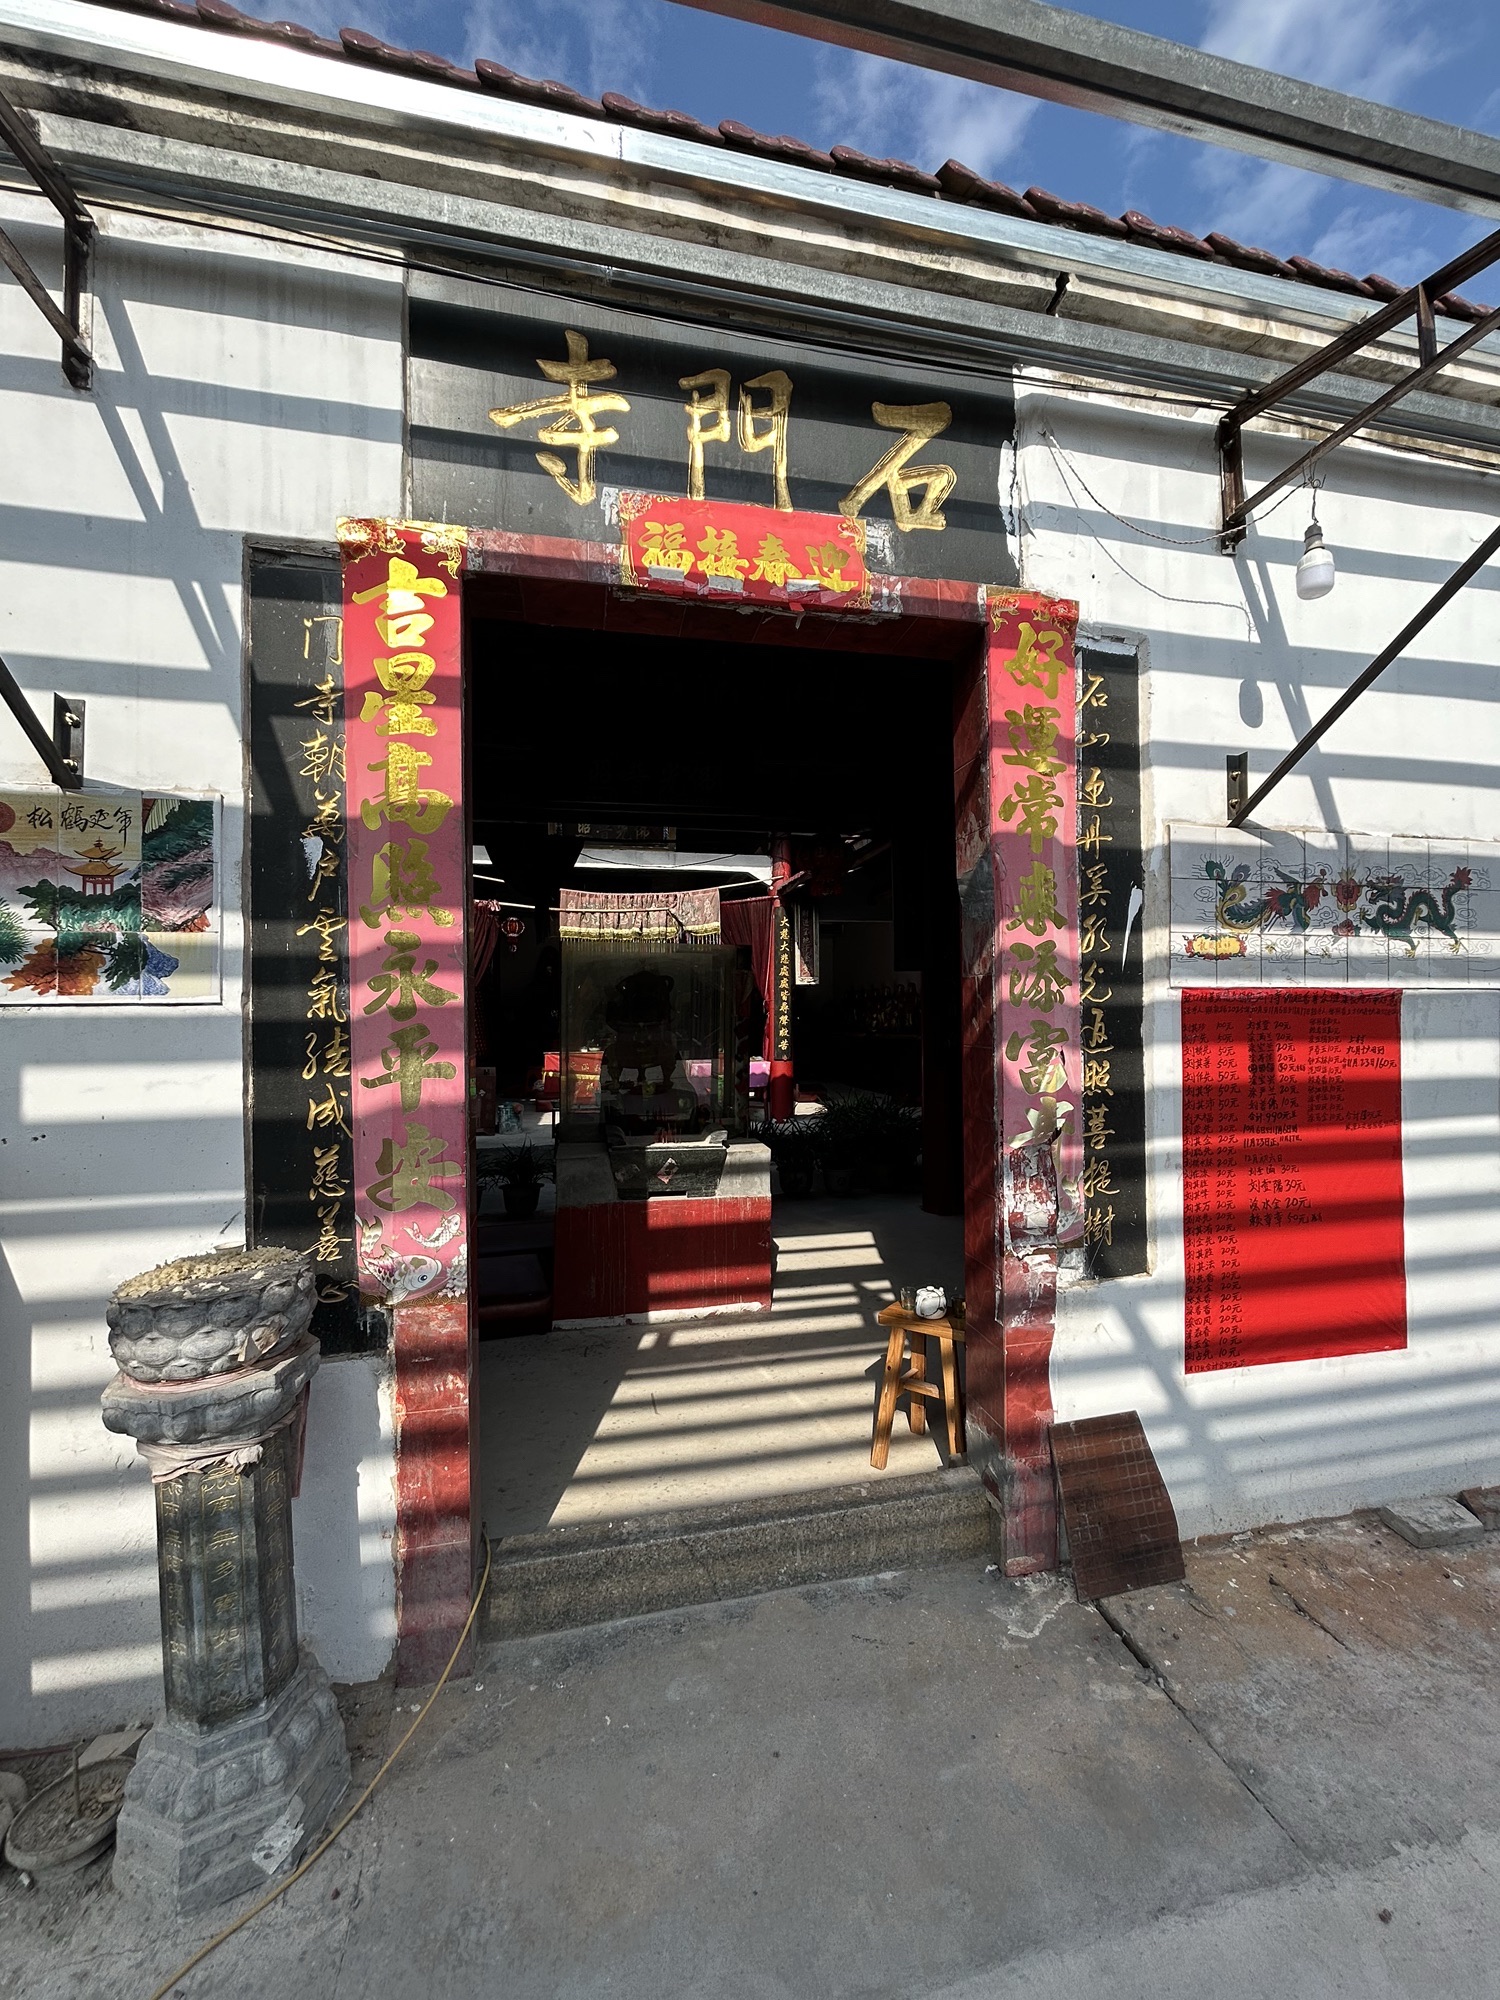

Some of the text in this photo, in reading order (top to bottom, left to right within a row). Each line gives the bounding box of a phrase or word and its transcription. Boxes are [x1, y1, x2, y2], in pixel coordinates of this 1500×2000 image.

[487, 329, 959, 532] 石門寺
[640, 521, 859, 592] 迎春接福
[352, 556, 463, 1213] 吉星高照永平安
[1273, 1021, 1291, 1030] 20元
[1217, 1033, 1234, 1043] 50元
[1276, 1033, 1294, 1041] 20元
[1218, 1046, 1235, 1056] 50元
[1275, 1042, 1296, 1052] 20元
[1277, 1053, 1296, 1062] 20元
[1216, 1058, 1238, 1069] 50元
[1217, 1070, 1240, 1082] 50元
[1279, 1074, 1297, 1083] 20元
[1217, 1083, 1241, 1097] 50元
[1280, 1085, 1299, 1094] 20元
[1217, 1098, 1240, 1111] 50元
[1281, 1097, 1299, 1108] 10元
[1218, 1112, 1238, 1122] 30元
[1218, 1125, 1237, 1133] 20元
[1218, 1135, 1239, 1144] 20元
[1217, 1146, 1237, 1155] 20元
[1217, 1157, 1237, 1167] 20元
[1216, 1169, 1236, 1178] 20元
[1281, 1164, 1300, 1174] 30元
[1216, 1179, 1236, 1188] 20元
[1284, 1179, 1306, 1193] 30元
[1216, 1200, 1236, 1210] 20元
[1284, 1196, 1312, 1210] 20元
[1215, 1212, 1235, 1221] 20元
[1287, 1212, 1309, 1224] 50元
[1215, 1224, 1236, 1233] 20元
[1217, 1235, 1238, 1245] 20元
[1221, 1246, 1239, 1255] 20元
[1221, 1259, 1240, 1269] 20元
[1221, 1271, 1241, 1281] 20元
[1221, 1281, 1241, 1290] 20元
[1220, 1292, 1242, 1303] 20元
[1220, 1303, 1242, 1314] 20元
[1219, 1315, 1243, 1324] 20元
[1219, 1325, 1242, 1335] 20元
[1219, 1335, 1242, 1346] 10元
[1219, 1347, 1240, 1358] 10元
